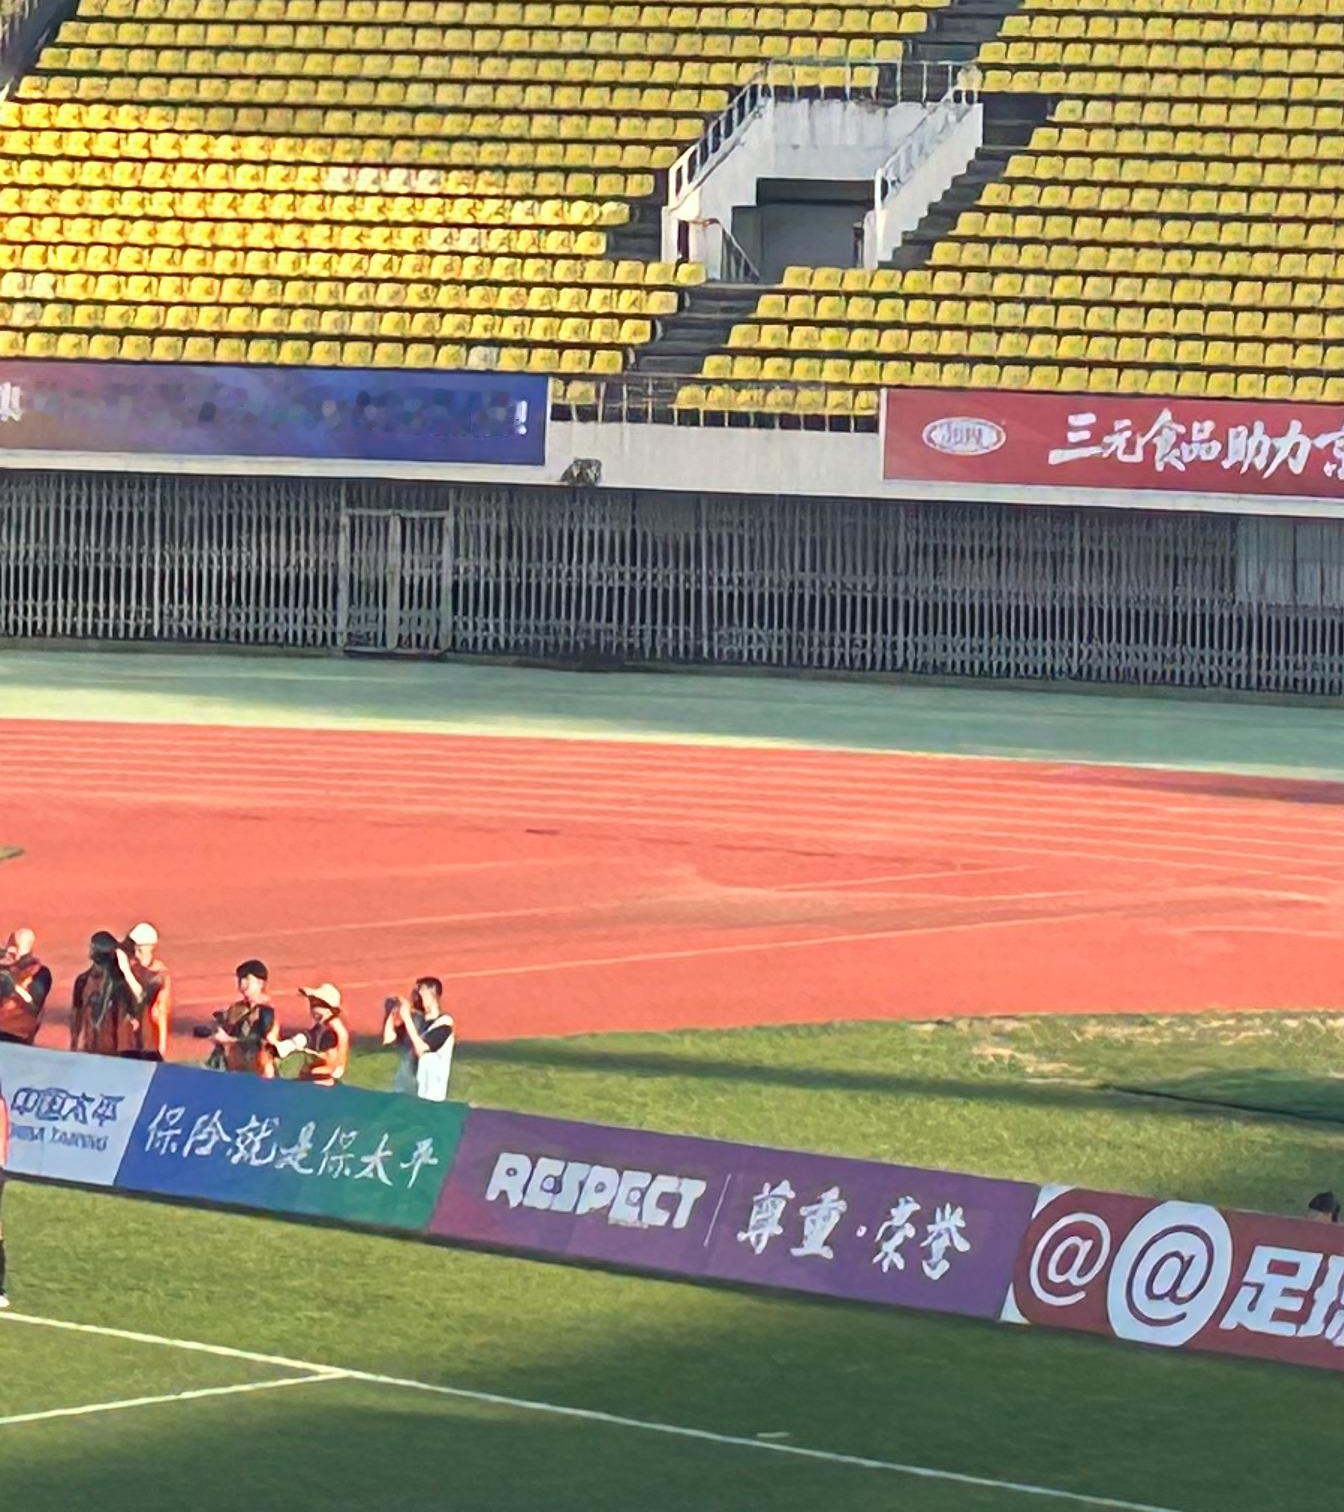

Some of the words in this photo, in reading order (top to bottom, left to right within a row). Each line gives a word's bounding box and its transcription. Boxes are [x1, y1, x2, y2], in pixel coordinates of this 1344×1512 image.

[146, 1103, 438, 1188] 保险就是保太平
[486, 1152, 706, 1229] RESPECT
